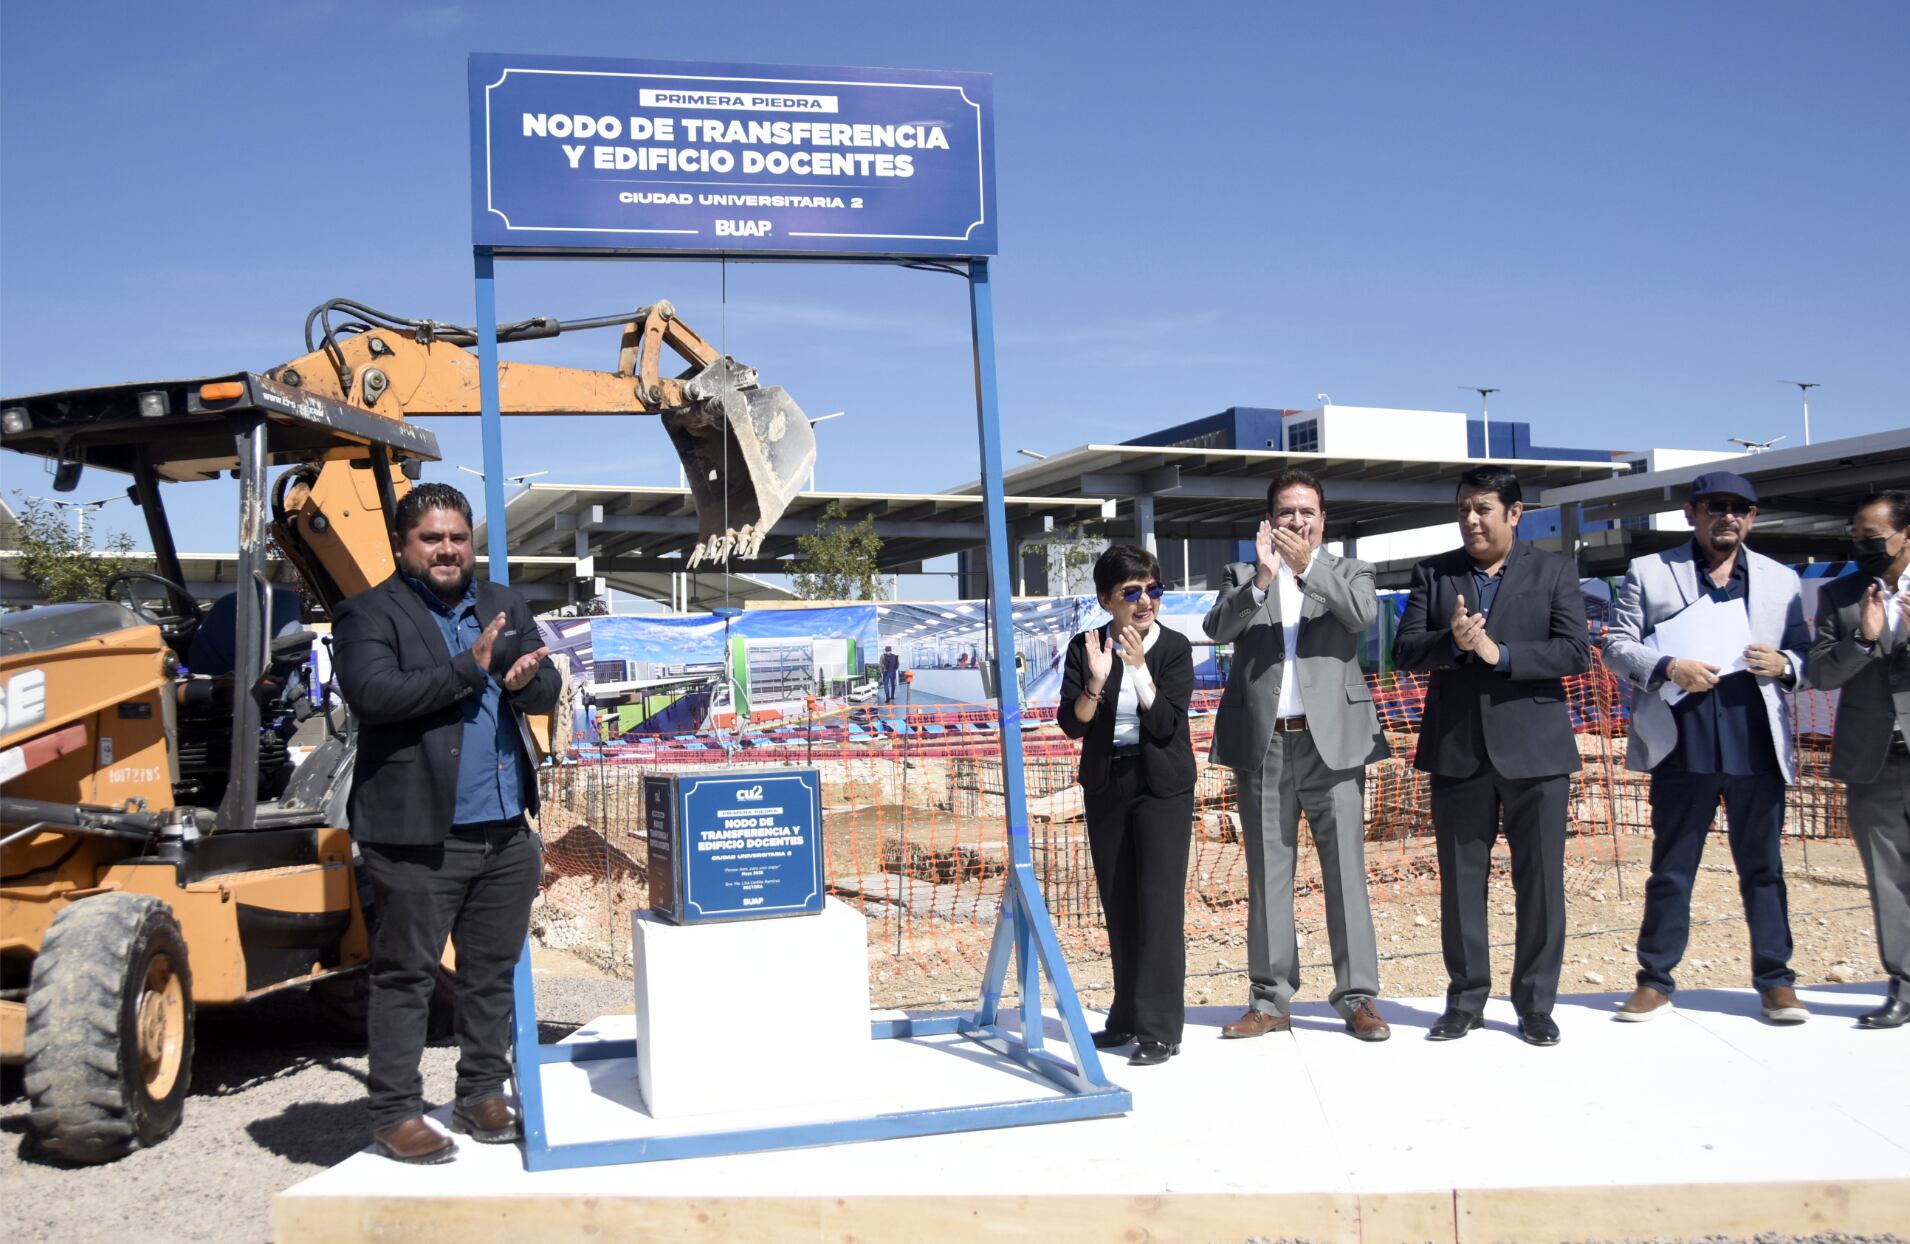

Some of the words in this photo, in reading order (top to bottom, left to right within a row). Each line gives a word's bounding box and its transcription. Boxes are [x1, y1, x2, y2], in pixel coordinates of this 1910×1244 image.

[654, 93, 745, 107] PRIMERA
[751, 96, 823, 109] PIEDRA
[522, 112, 622, 140] NODO
[630, 116, 675, 141] DE
[681, 118, 950, 150] TRANSFERENCIA
[562, 144, 586, 169] Y
[593, 145, 735, 174] EDIFICIO
[742, 150, 915, 178] DOCENTES
[619, 191, 694, 205] CIUDAD
[698, 194, 845, 208] UNIVERSITARIA
[850, 197, 864, 209] 2
[0, 669, 45, 730] E
[724, 818, 758, 829] NODO
[758, 817, 774, 827] DE
[700, 826, 791, 841] TRANSFERENCIA
[792, 825, 801, 836] Y
[698, 839, 745, 851] EDIFICIO
[746, 836, 804, 849] DOCENTES
[737, 851, 786, 860] UNIVERSITARIA
[743, 897, 764, 906] BUAP
